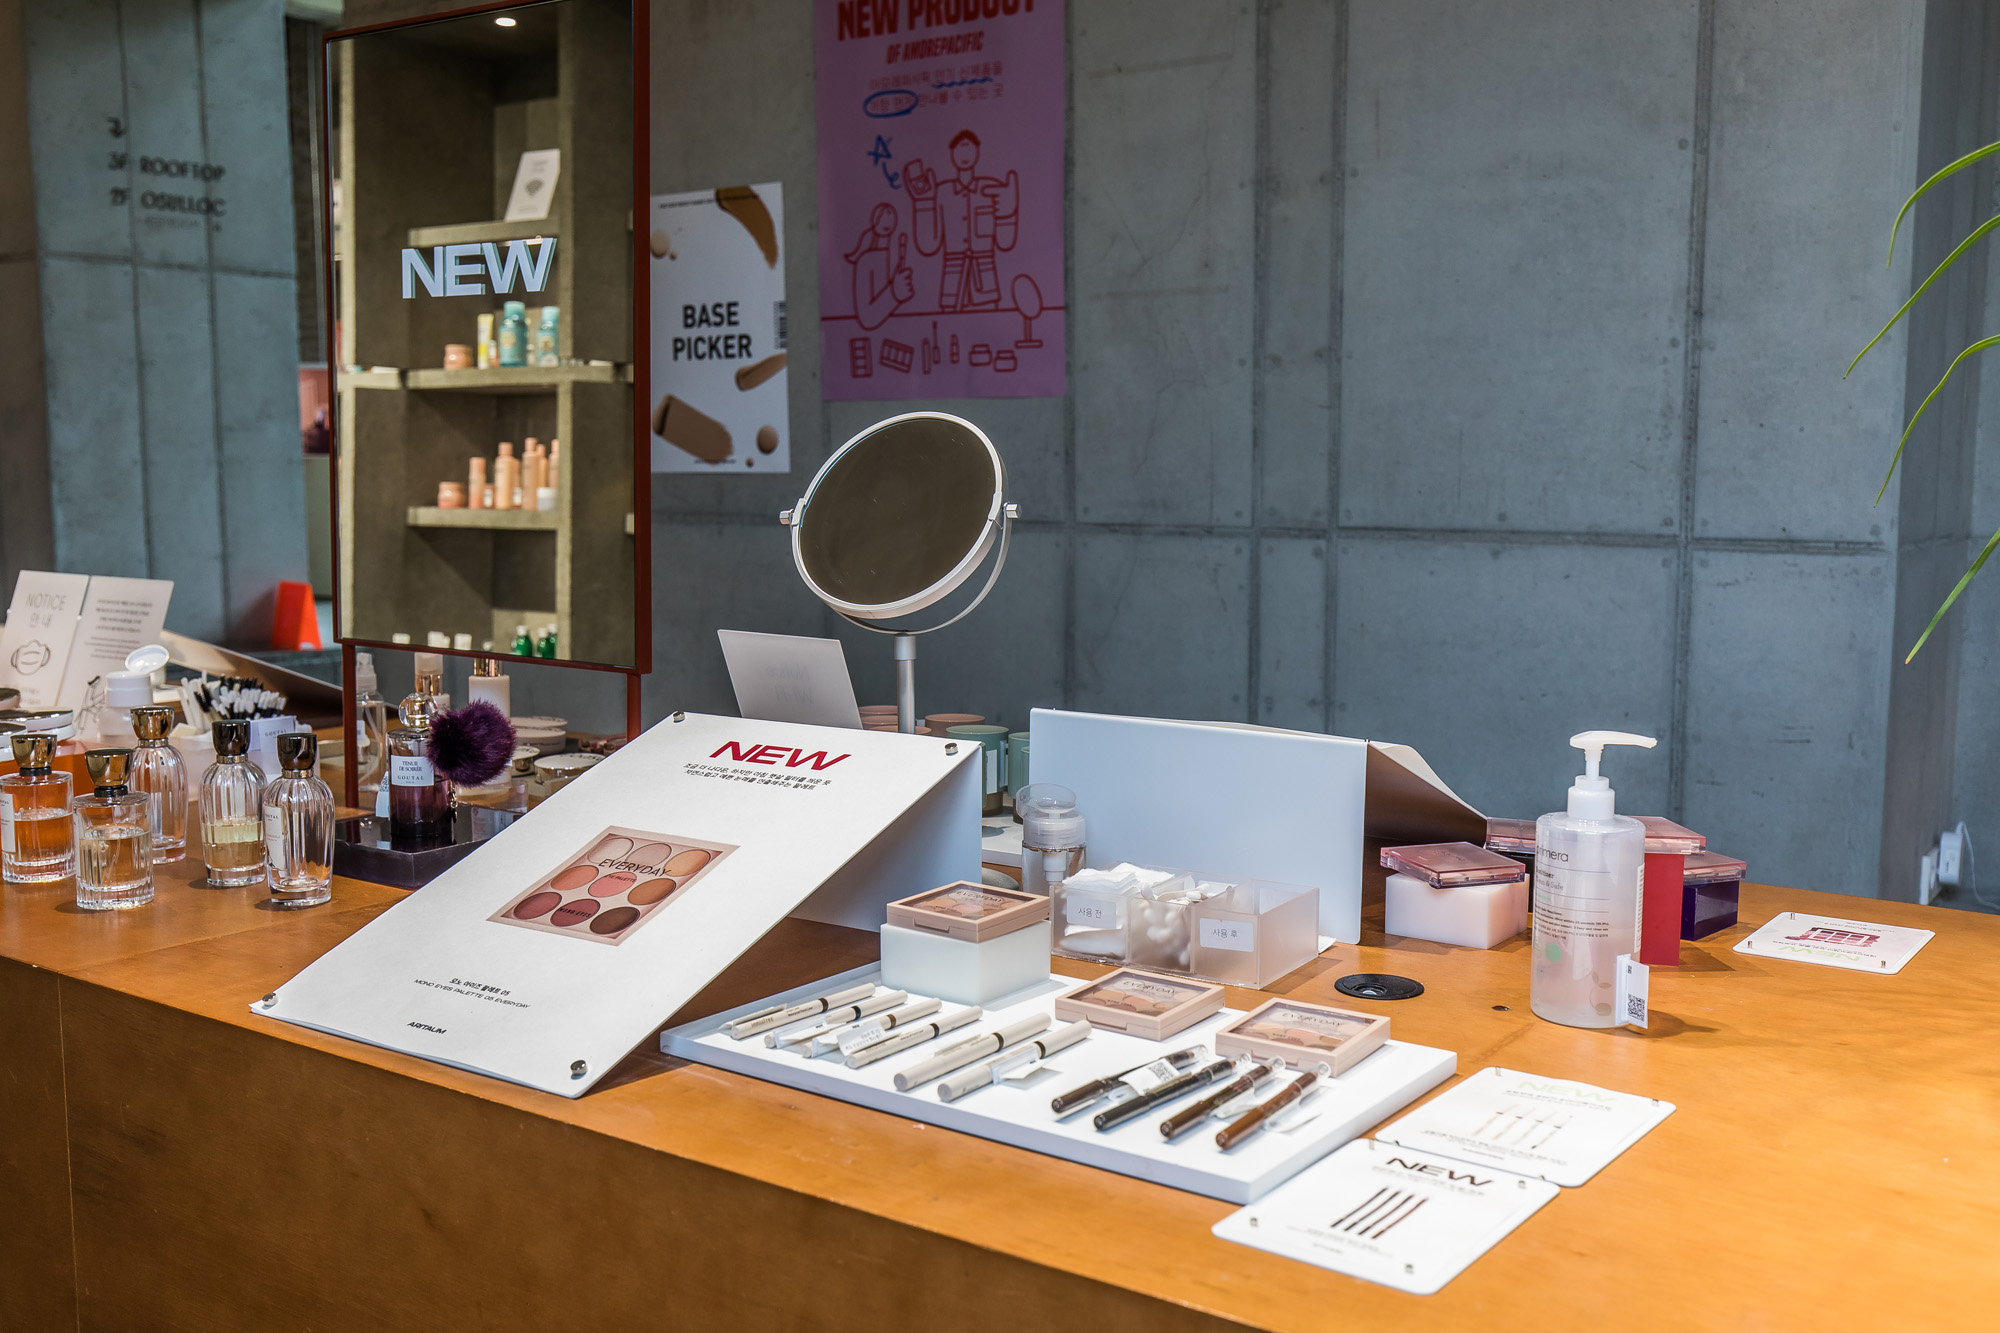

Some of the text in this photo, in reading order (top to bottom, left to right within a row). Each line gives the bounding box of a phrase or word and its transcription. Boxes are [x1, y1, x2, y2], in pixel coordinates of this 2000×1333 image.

[837, 0, 899, 41] NEW
[886, 31, 984, 64] OF AMOREPACIFIC
[140, 155, 226, 183] ROOFTOP
[401, 237, 557, 299] NEW
[682, 301, 740, 329] BASE
[672, 333, 753, 361] PICKER
[25, 593, 67, 611] NOTICE
[709, 740, 852, 771] NEW
[598, 858, 671, 877] EVERYDAY
[615, 875, 637, 883] PALETTE
[1551, 881, 1564, 890] Safe
[575, 910, 592, 918] EYES
[1078, 907, 1102, 919] 사용 전
[1212, 928, 1238, 938] 사용 후
[1777, 945, 1861, 962] NEW
[449, 977, 462, 985] 모노
[463, 980, 482, 990] 아이즈
[1123, 980, 1176, 994] EVERYDAY
[413, 979, 435, 987] MONO
[434, 983, 453, 991] EYES
[453, 987, 484, 998] PALETTE
[494, 997, 531, 1008] EVERYDAY
[406, 1021, 447, 1034] ARITAUM
[1281, 1012, 1344, 1027] EVERYDAY
[1517, 1081, 1617, 1102] NEW
[1386, 1157, 1494, 1187] NEW
